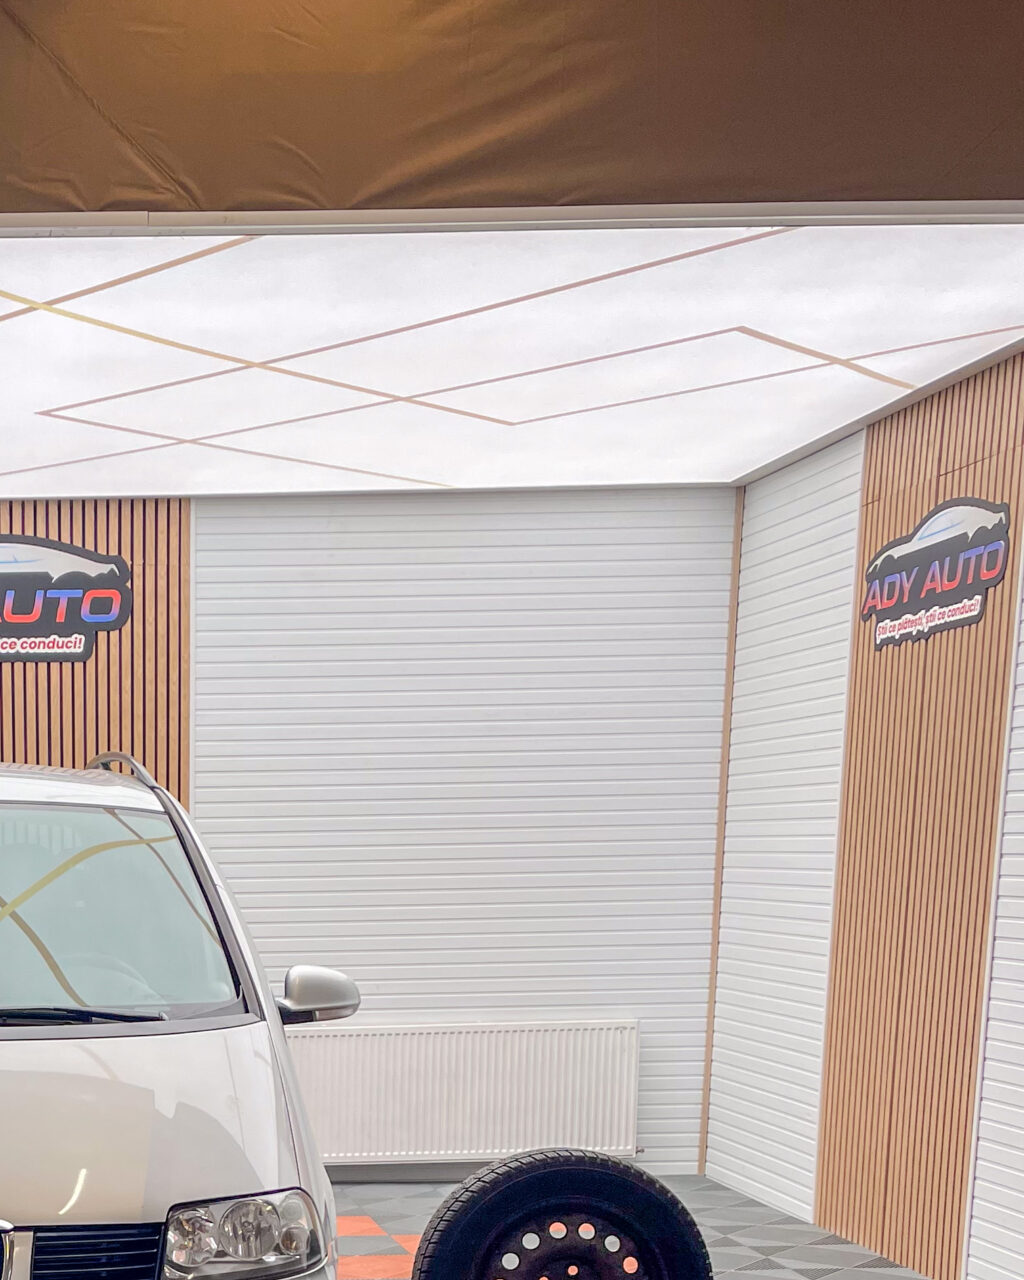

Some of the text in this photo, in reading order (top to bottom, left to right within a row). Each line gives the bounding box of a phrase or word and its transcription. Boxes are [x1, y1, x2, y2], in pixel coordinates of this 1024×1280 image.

[862, 540, 1005, 614] ADY AUTO
[0, 640, 17, 650] ce
[20, 637, 83, 650] conduci!
